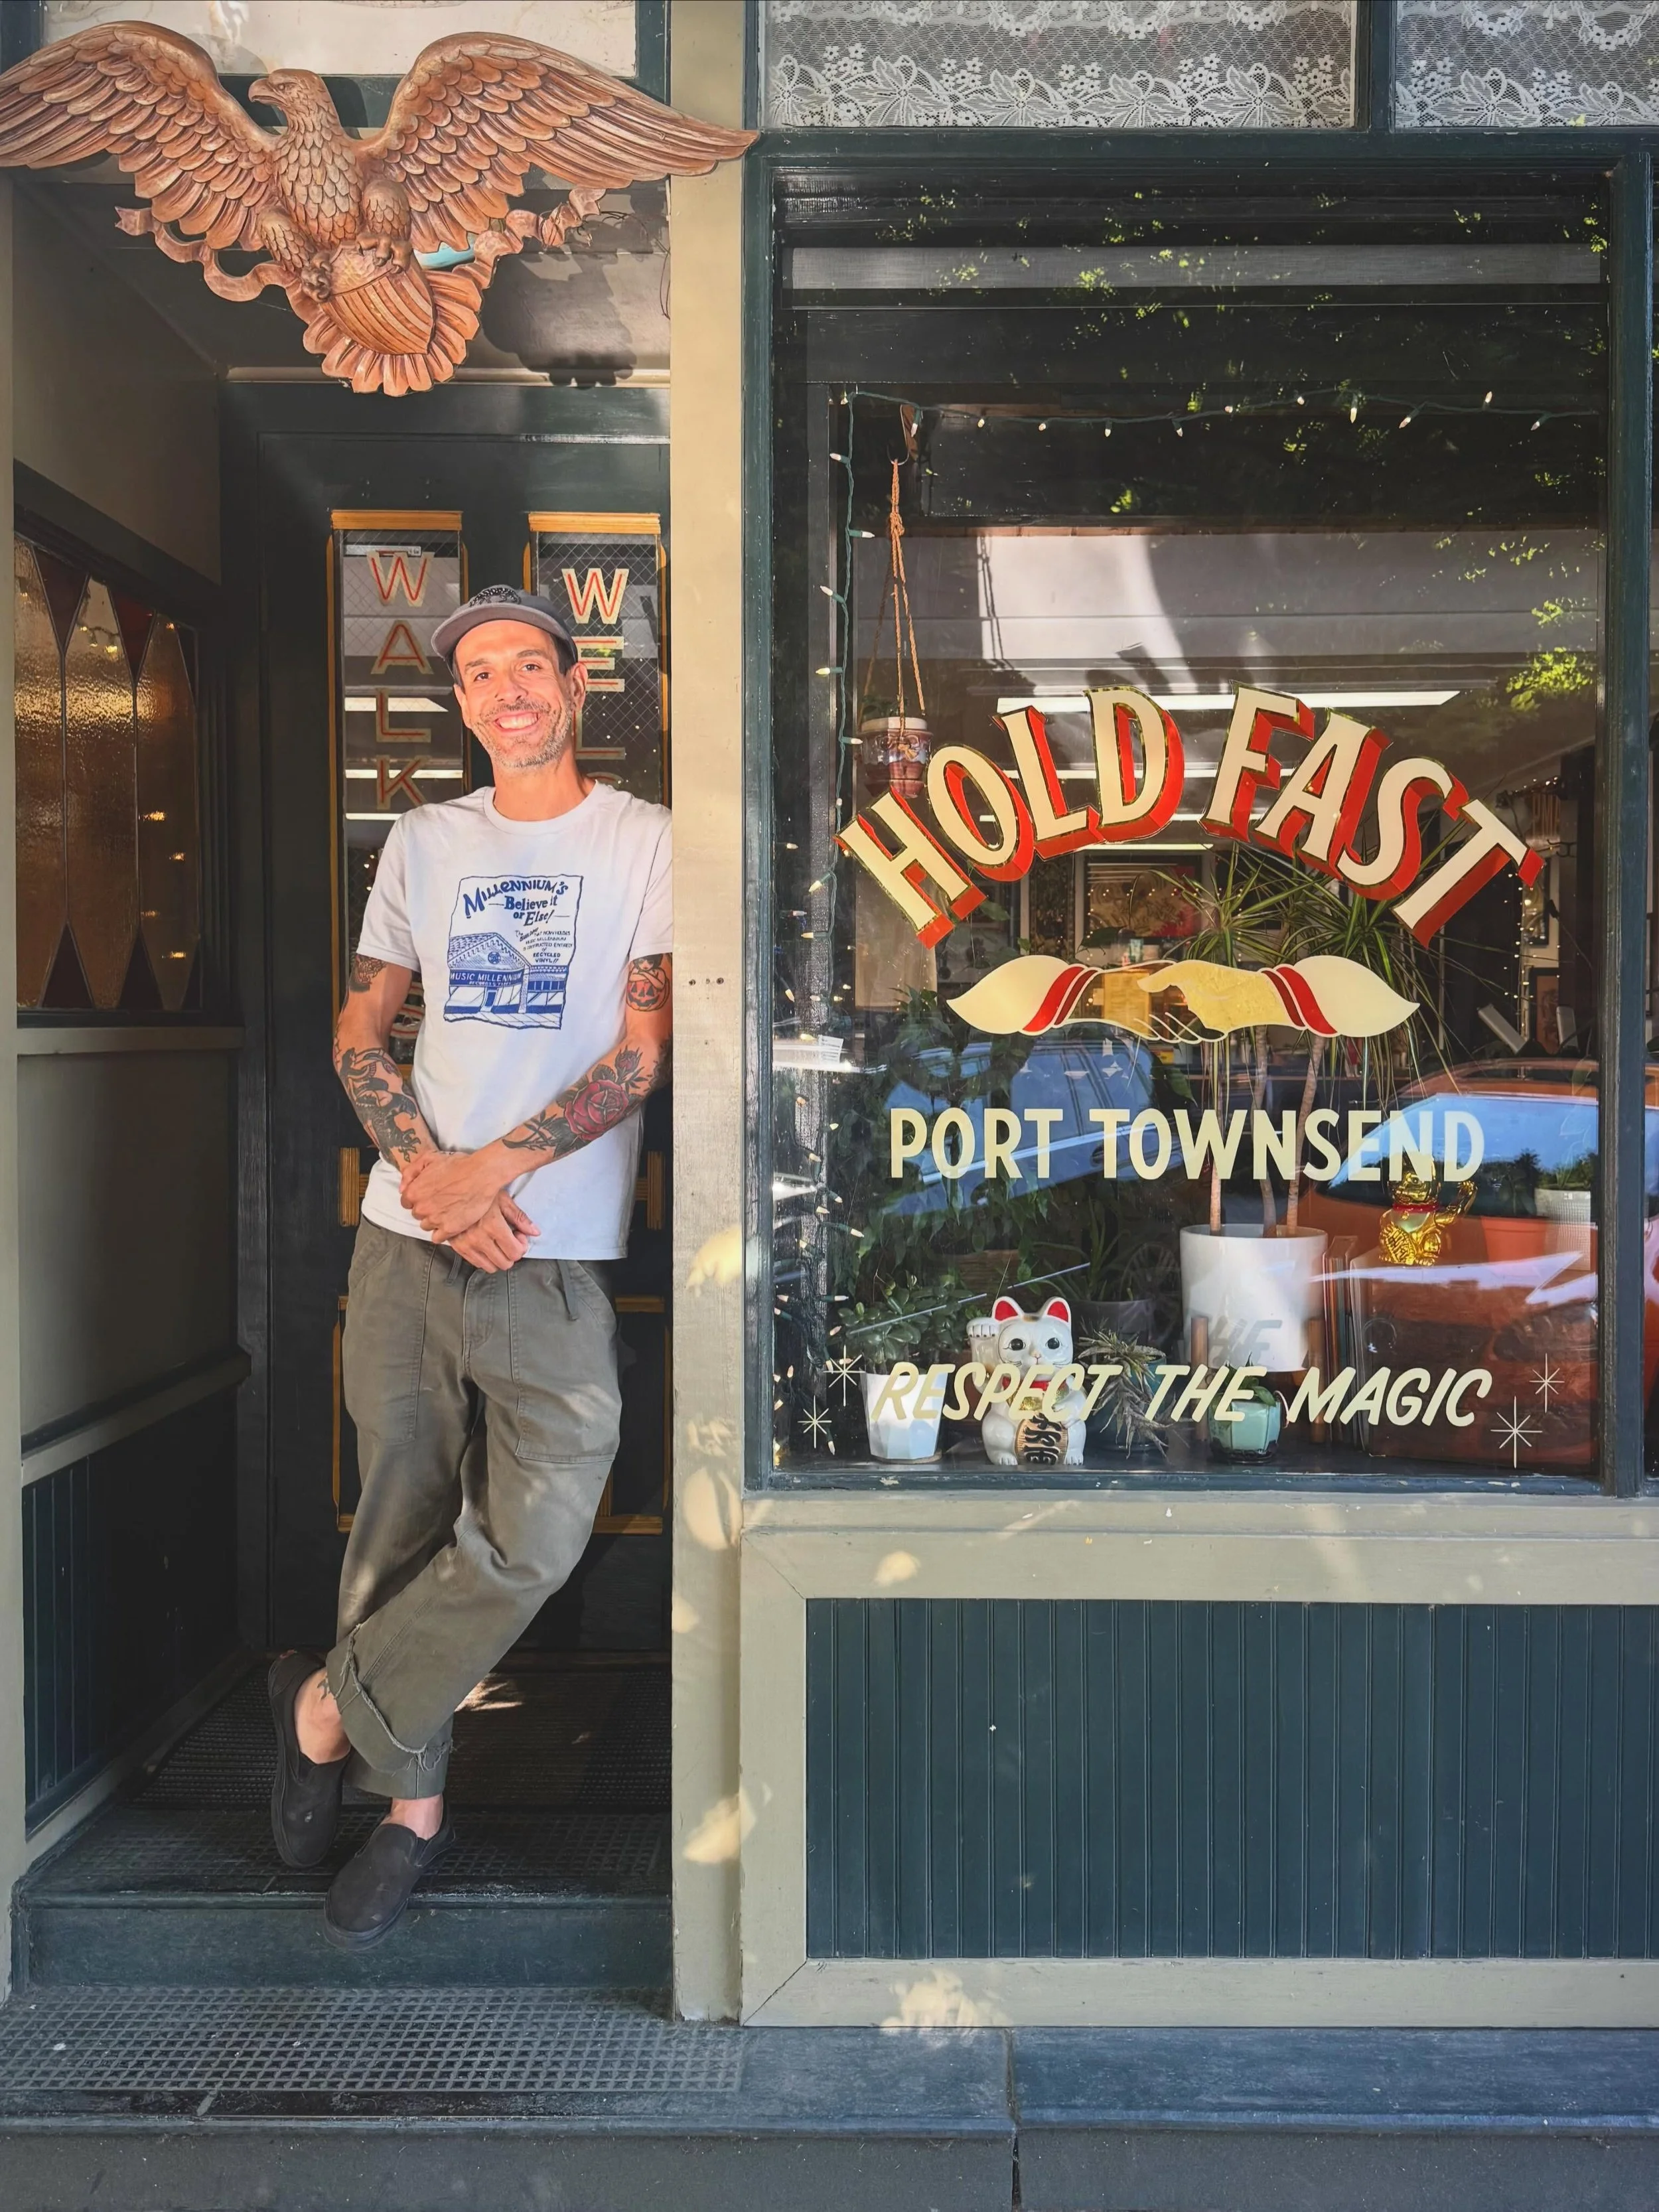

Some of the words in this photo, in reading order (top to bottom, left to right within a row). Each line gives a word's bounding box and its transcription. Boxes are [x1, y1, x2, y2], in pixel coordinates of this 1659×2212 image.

[833, 684, 1186, 949] HOLD
[1200, 680, 1545, 949] FAST
[504, 895, 548, 911] Believe
[523, 909, 555, 926] Else!
[477, 972, 522, 982] MILLENNIUM
[892, 1108, 1062, 1179] PORT
[1090, 1108, 1485, 1181] TOWNSEND
[872, 1363, 1123, 1422] RESPECT
[1145, 1364, 1267, 1422] THE
[1286, 1366, 1492, 1427] MAGIC
